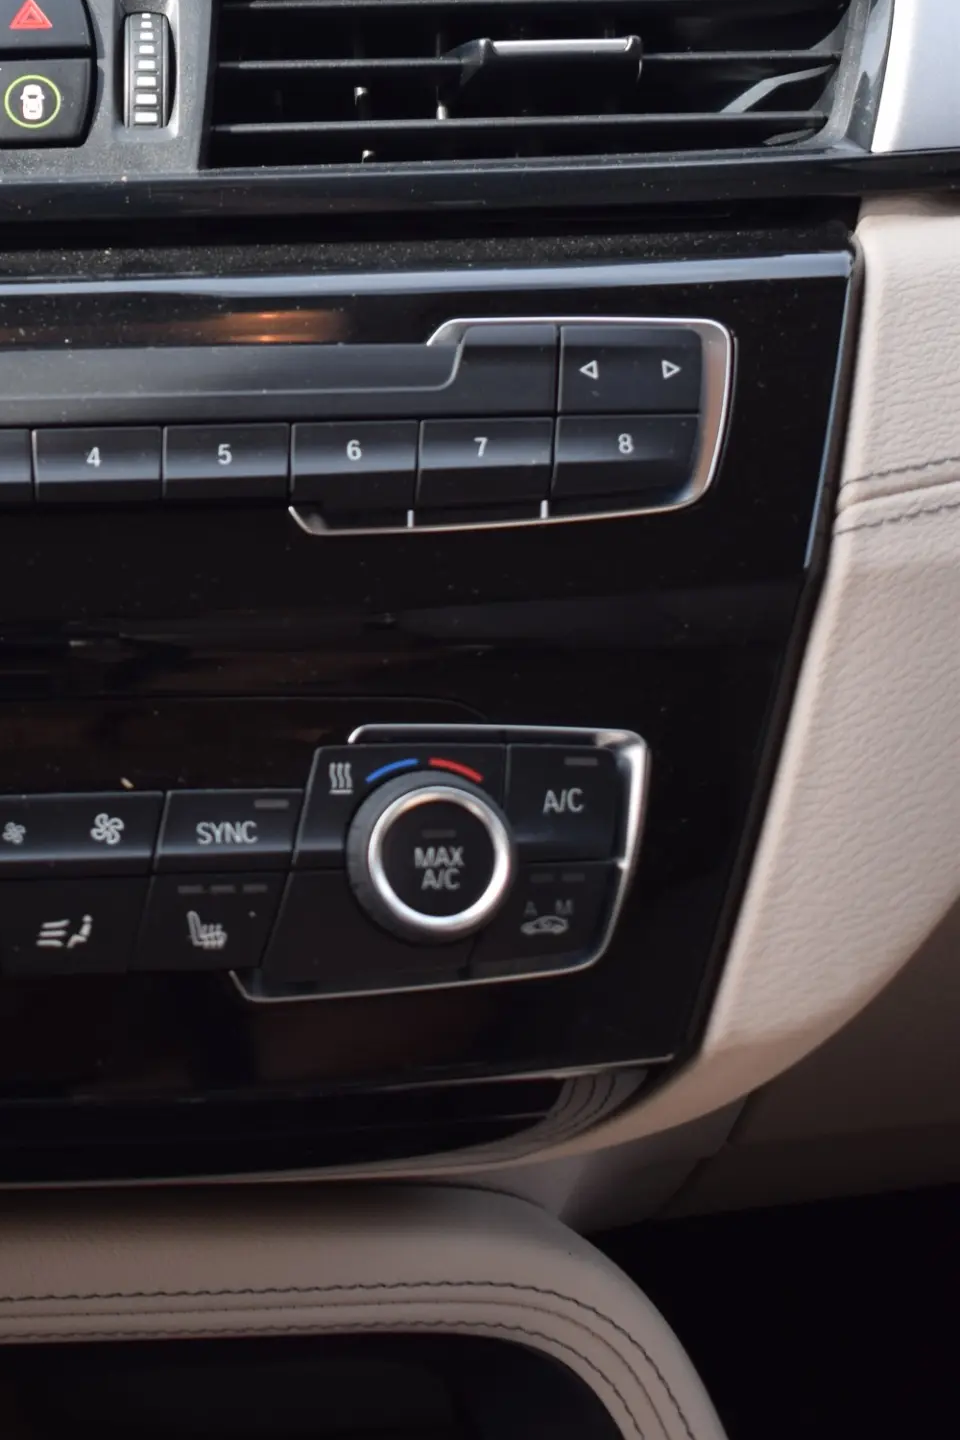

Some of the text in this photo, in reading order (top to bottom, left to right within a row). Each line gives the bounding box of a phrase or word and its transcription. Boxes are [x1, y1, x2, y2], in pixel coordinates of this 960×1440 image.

[217, 443, 232, 465] 5
[346, 439, 362, 461] 6
[474, 436, 488, 458] 7
[618, 433, 634, 454] 8
[86, 445, 102, 468] 4
[543, 788, 583, 814] A/C
[196, 821, 258, 846] SYNC
[414, 846, 465, 870] MAX
[421, 868, 459, 891] A/C
